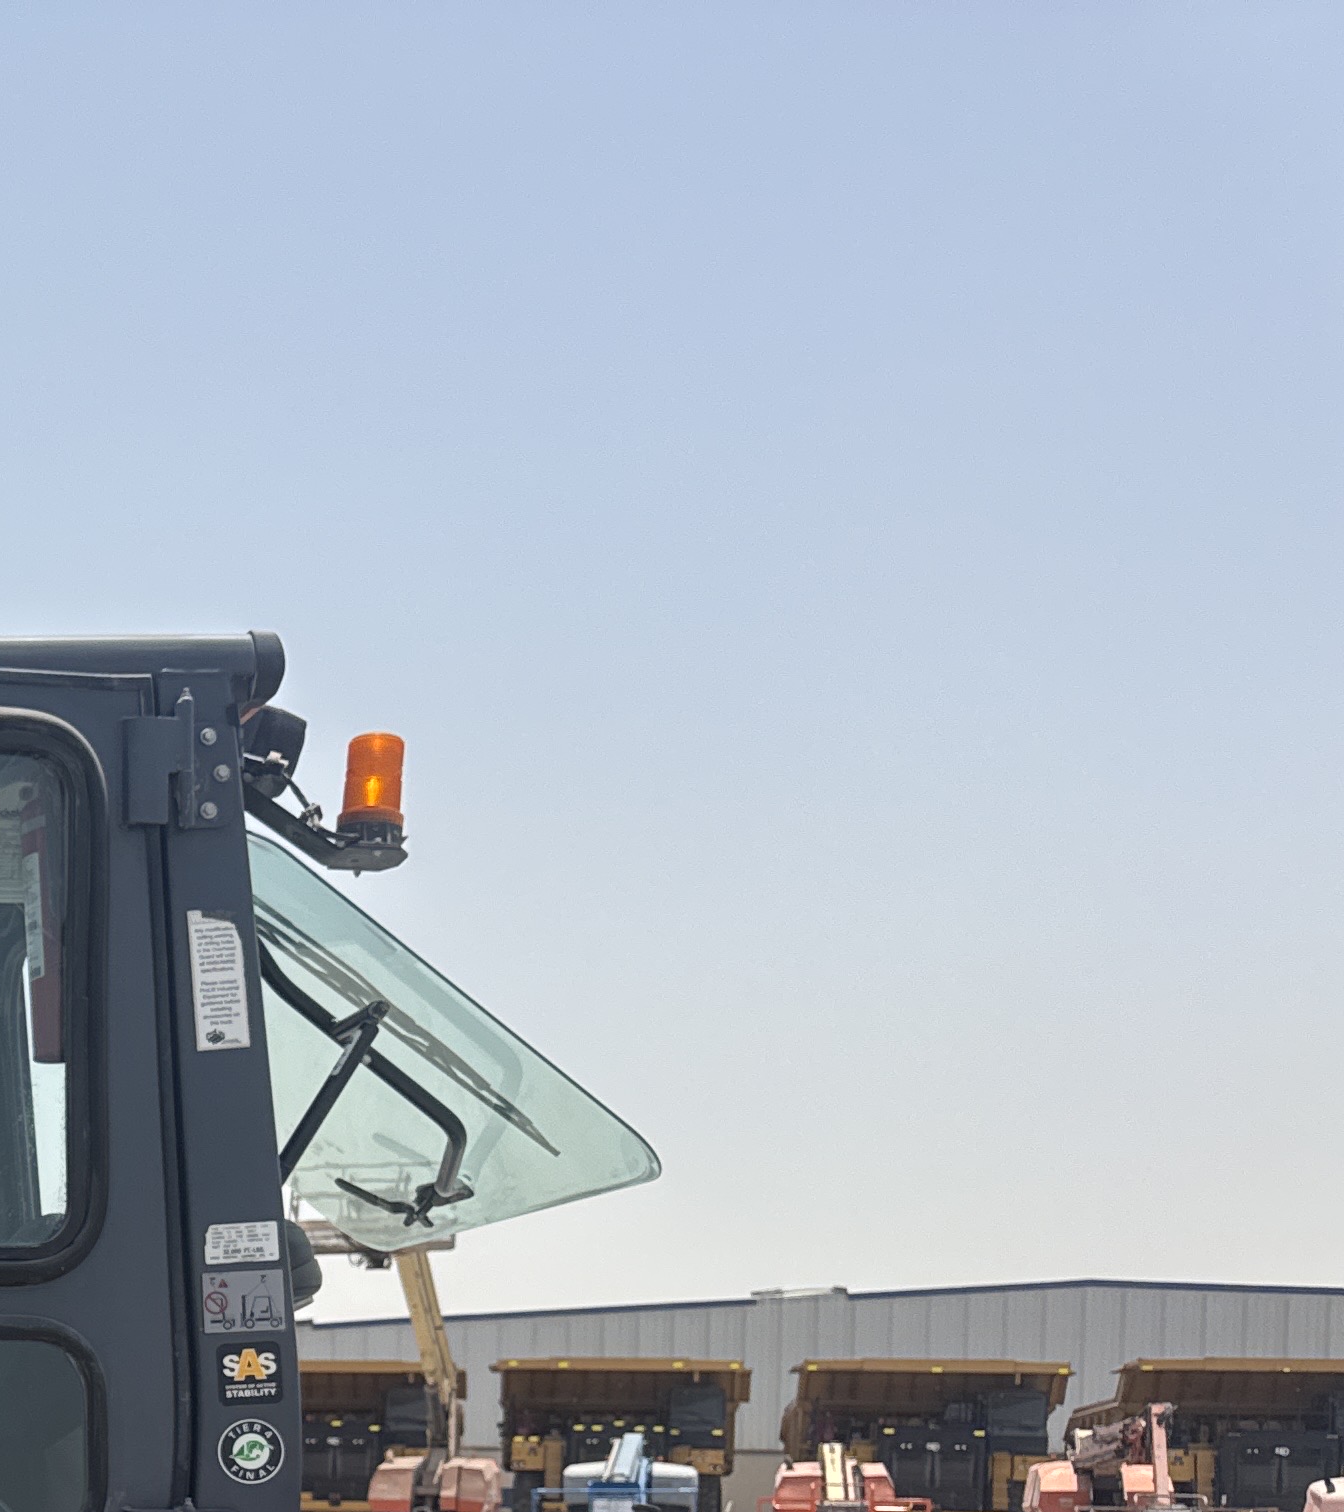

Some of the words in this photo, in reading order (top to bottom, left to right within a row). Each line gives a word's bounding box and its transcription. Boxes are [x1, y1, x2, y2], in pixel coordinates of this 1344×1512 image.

[222, 1348, 277, 1381] SAS
[225, 1388, 277, 1399] STABILITY
[228, 1423, 262, 1440] TIER
[264, 1430, 274, 1440] 4
[230, 1464, 275, 1480] FINAL
